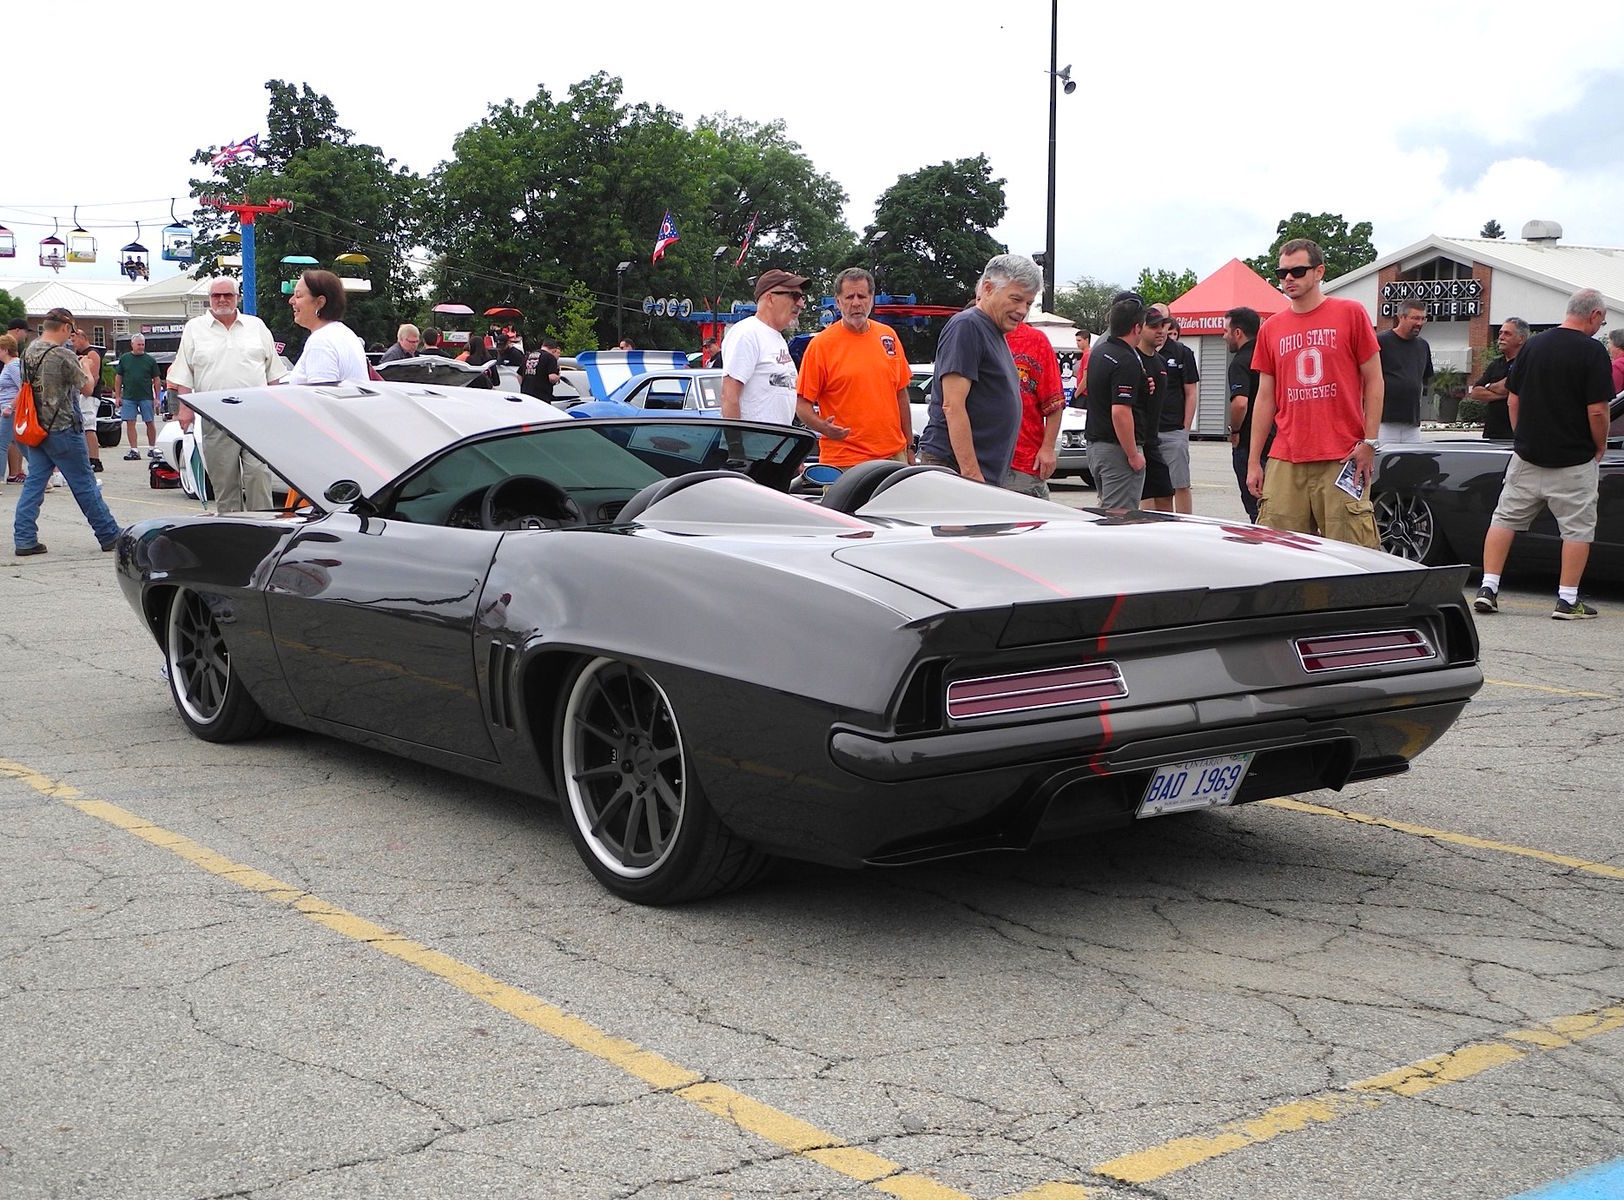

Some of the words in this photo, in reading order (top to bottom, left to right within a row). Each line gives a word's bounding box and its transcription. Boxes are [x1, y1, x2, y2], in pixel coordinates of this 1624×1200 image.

[1384, 284, 1477, 297] RHODES
[1383, 301, 1476, 315] CTER
[1280, 333, 1303, 356] OHIO
[1306, 328, 1337, 349] STATE
[1295, 347, 1324, 387] O
[1287, 382, 1338, 402] BUCKEYES
[1146, 771, 1188, 802] BAD
[1191, 764, 1242, 795] 1969
